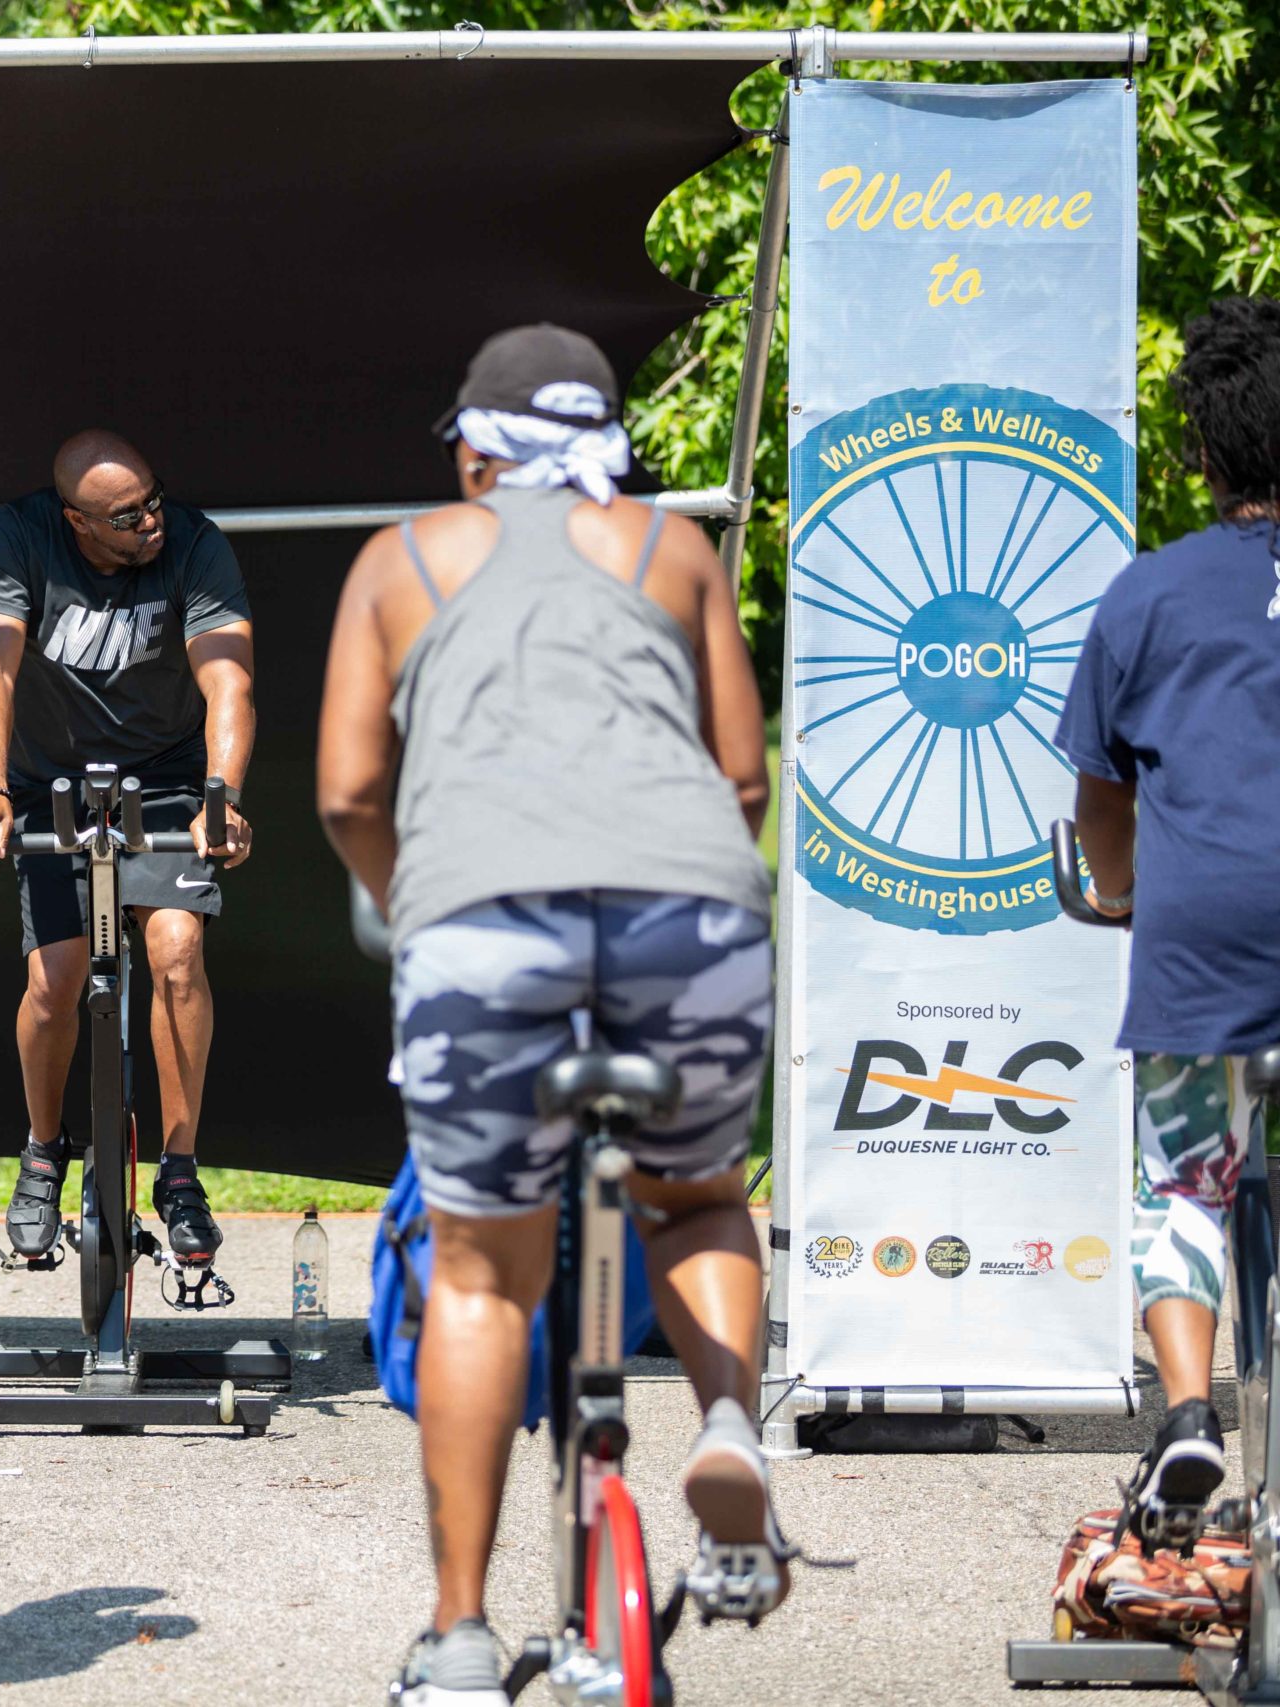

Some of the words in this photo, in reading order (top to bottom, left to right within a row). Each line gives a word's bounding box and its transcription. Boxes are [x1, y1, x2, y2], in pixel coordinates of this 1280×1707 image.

[818, 165, 1093, 232] Welcome
[927, 253, 985, 307] to
[818, 411, 932, 473] Wheels
[940, 407, 964, 432] &
[972, 406, 1103, 474] Wellness
[43, 600, 167, 671] NIKE
[900, 642, 1026, 678] POGOH
[803, 829, 831, 864] in
[835, 850, 1054, 919] Westinghouse
[896, 1001, 994, 1022] Sponsored
[999, 1003, 1021, 1024] by
[833, 1039, 1085, 1135] DLC
[856, 1140, 958, 1155] DUQUESNE
[962, 1141, 1017, 1155] LIGHT
[1021, 1142, 1051, 1157] CO.
[980, 1262, 1024, 1270] RUACH
